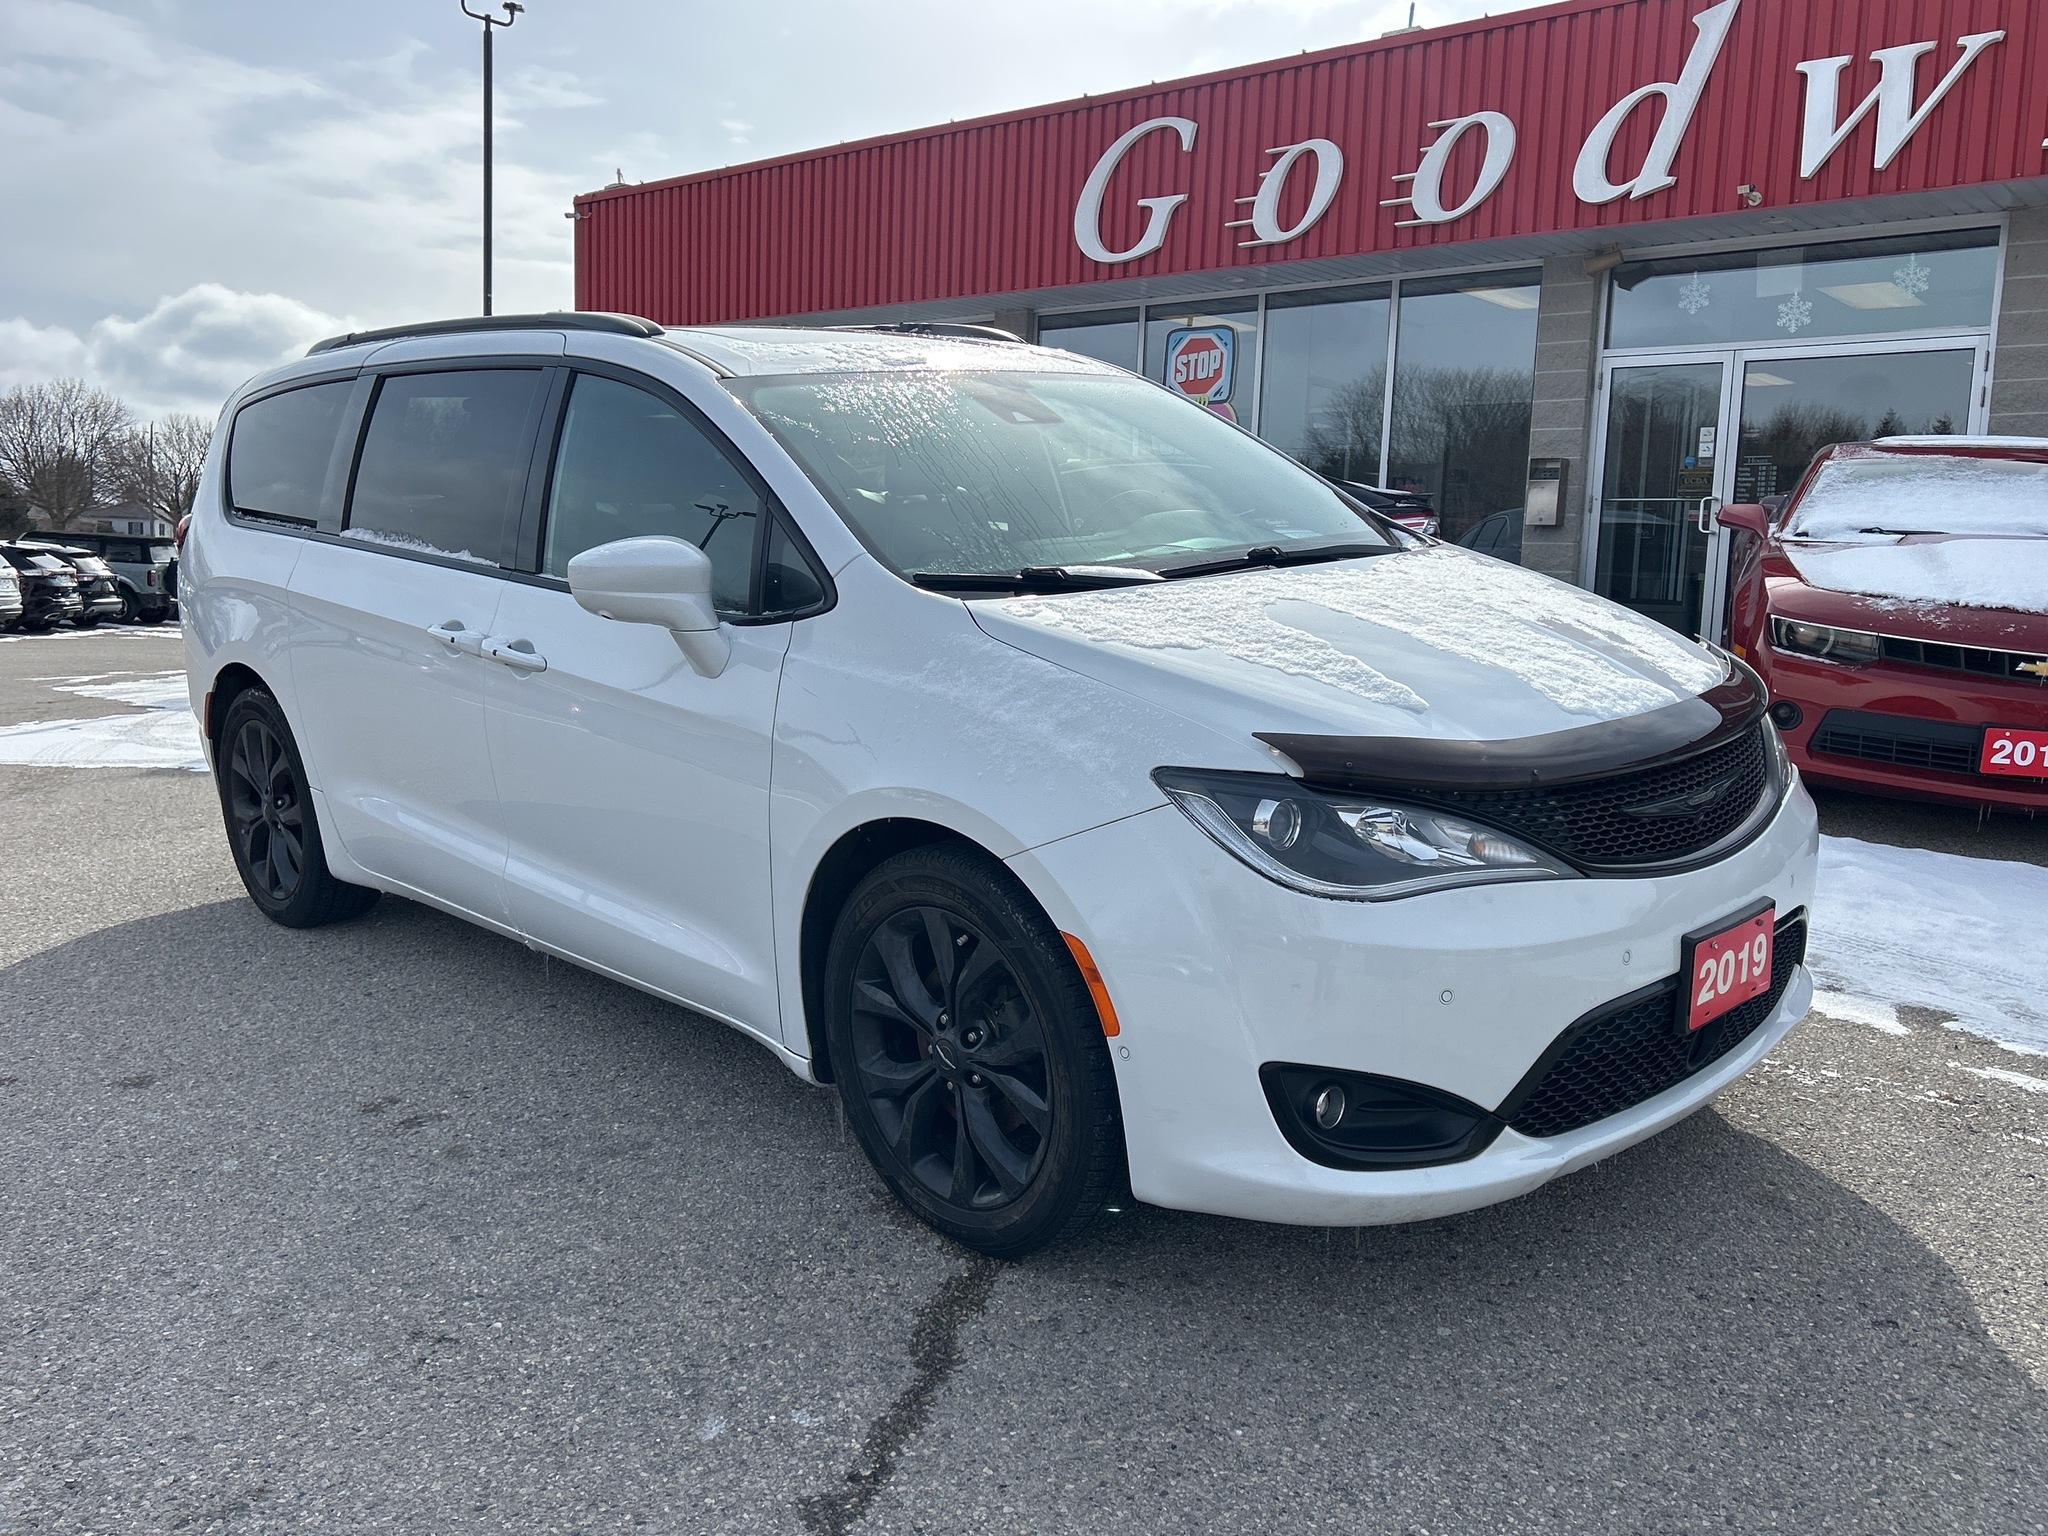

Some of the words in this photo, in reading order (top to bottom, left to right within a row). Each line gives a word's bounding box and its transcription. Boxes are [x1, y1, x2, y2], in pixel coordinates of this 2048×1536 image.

[1073, 0, 2048, 265] Goodw
[1175, 349, 1221, 383] STOP
[1684, 477, 1708, 485] UCDA
[1697, 933, 1767, 1006] 2019
